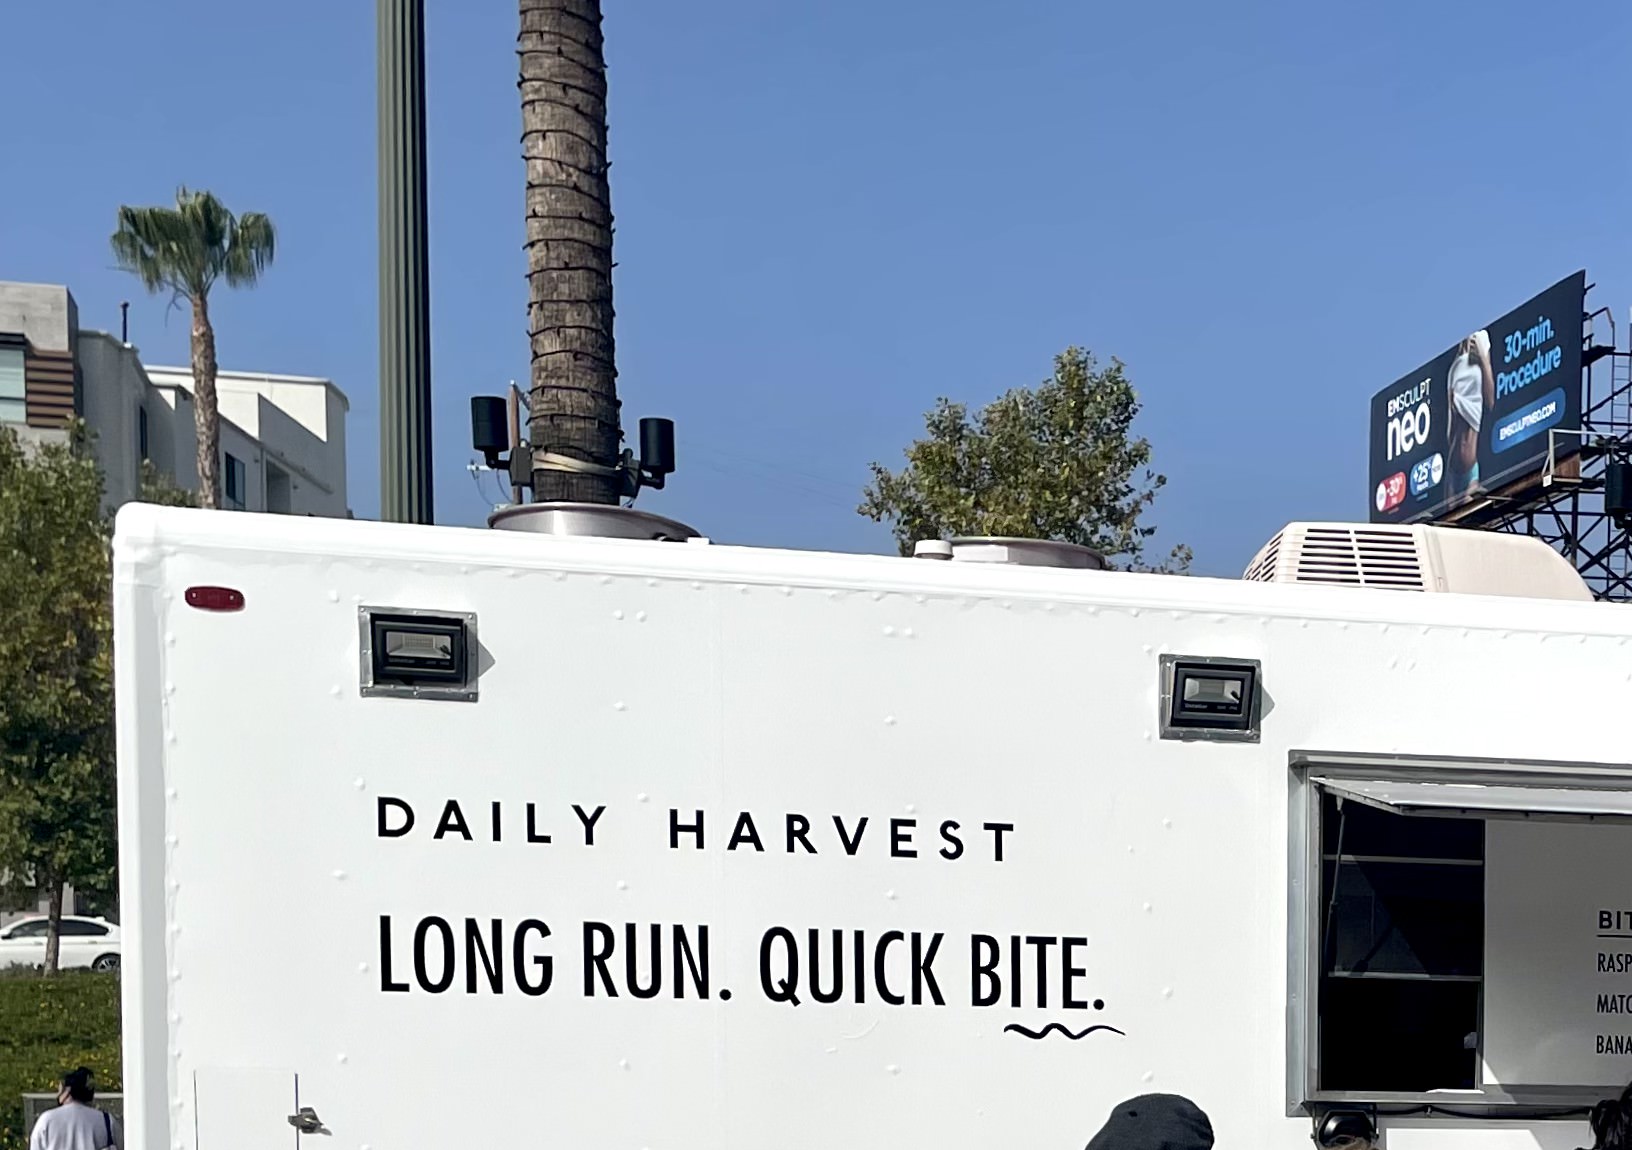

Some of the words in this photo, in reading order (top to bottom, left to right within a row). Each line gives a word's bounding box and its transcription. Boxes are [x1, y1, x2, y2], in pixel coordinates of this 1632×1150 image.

[1503, 315, 1555, 363] 30-min.
[1387, 377, 1431, 417] EMSCULPT
[1496, 345, 1562, 400] Procedure
[1387, 402, 1431, 461] neo
[377, 796, 607, 846] DAILY
[669, 808, 1014, 862] HARVEST
[379, 915, 553, 997] LONG
[583, 921, 732, 1001] RUN.
[759, 926, 946, 1007] QUICK
[971, 933, 1105, 1011] BITE.
